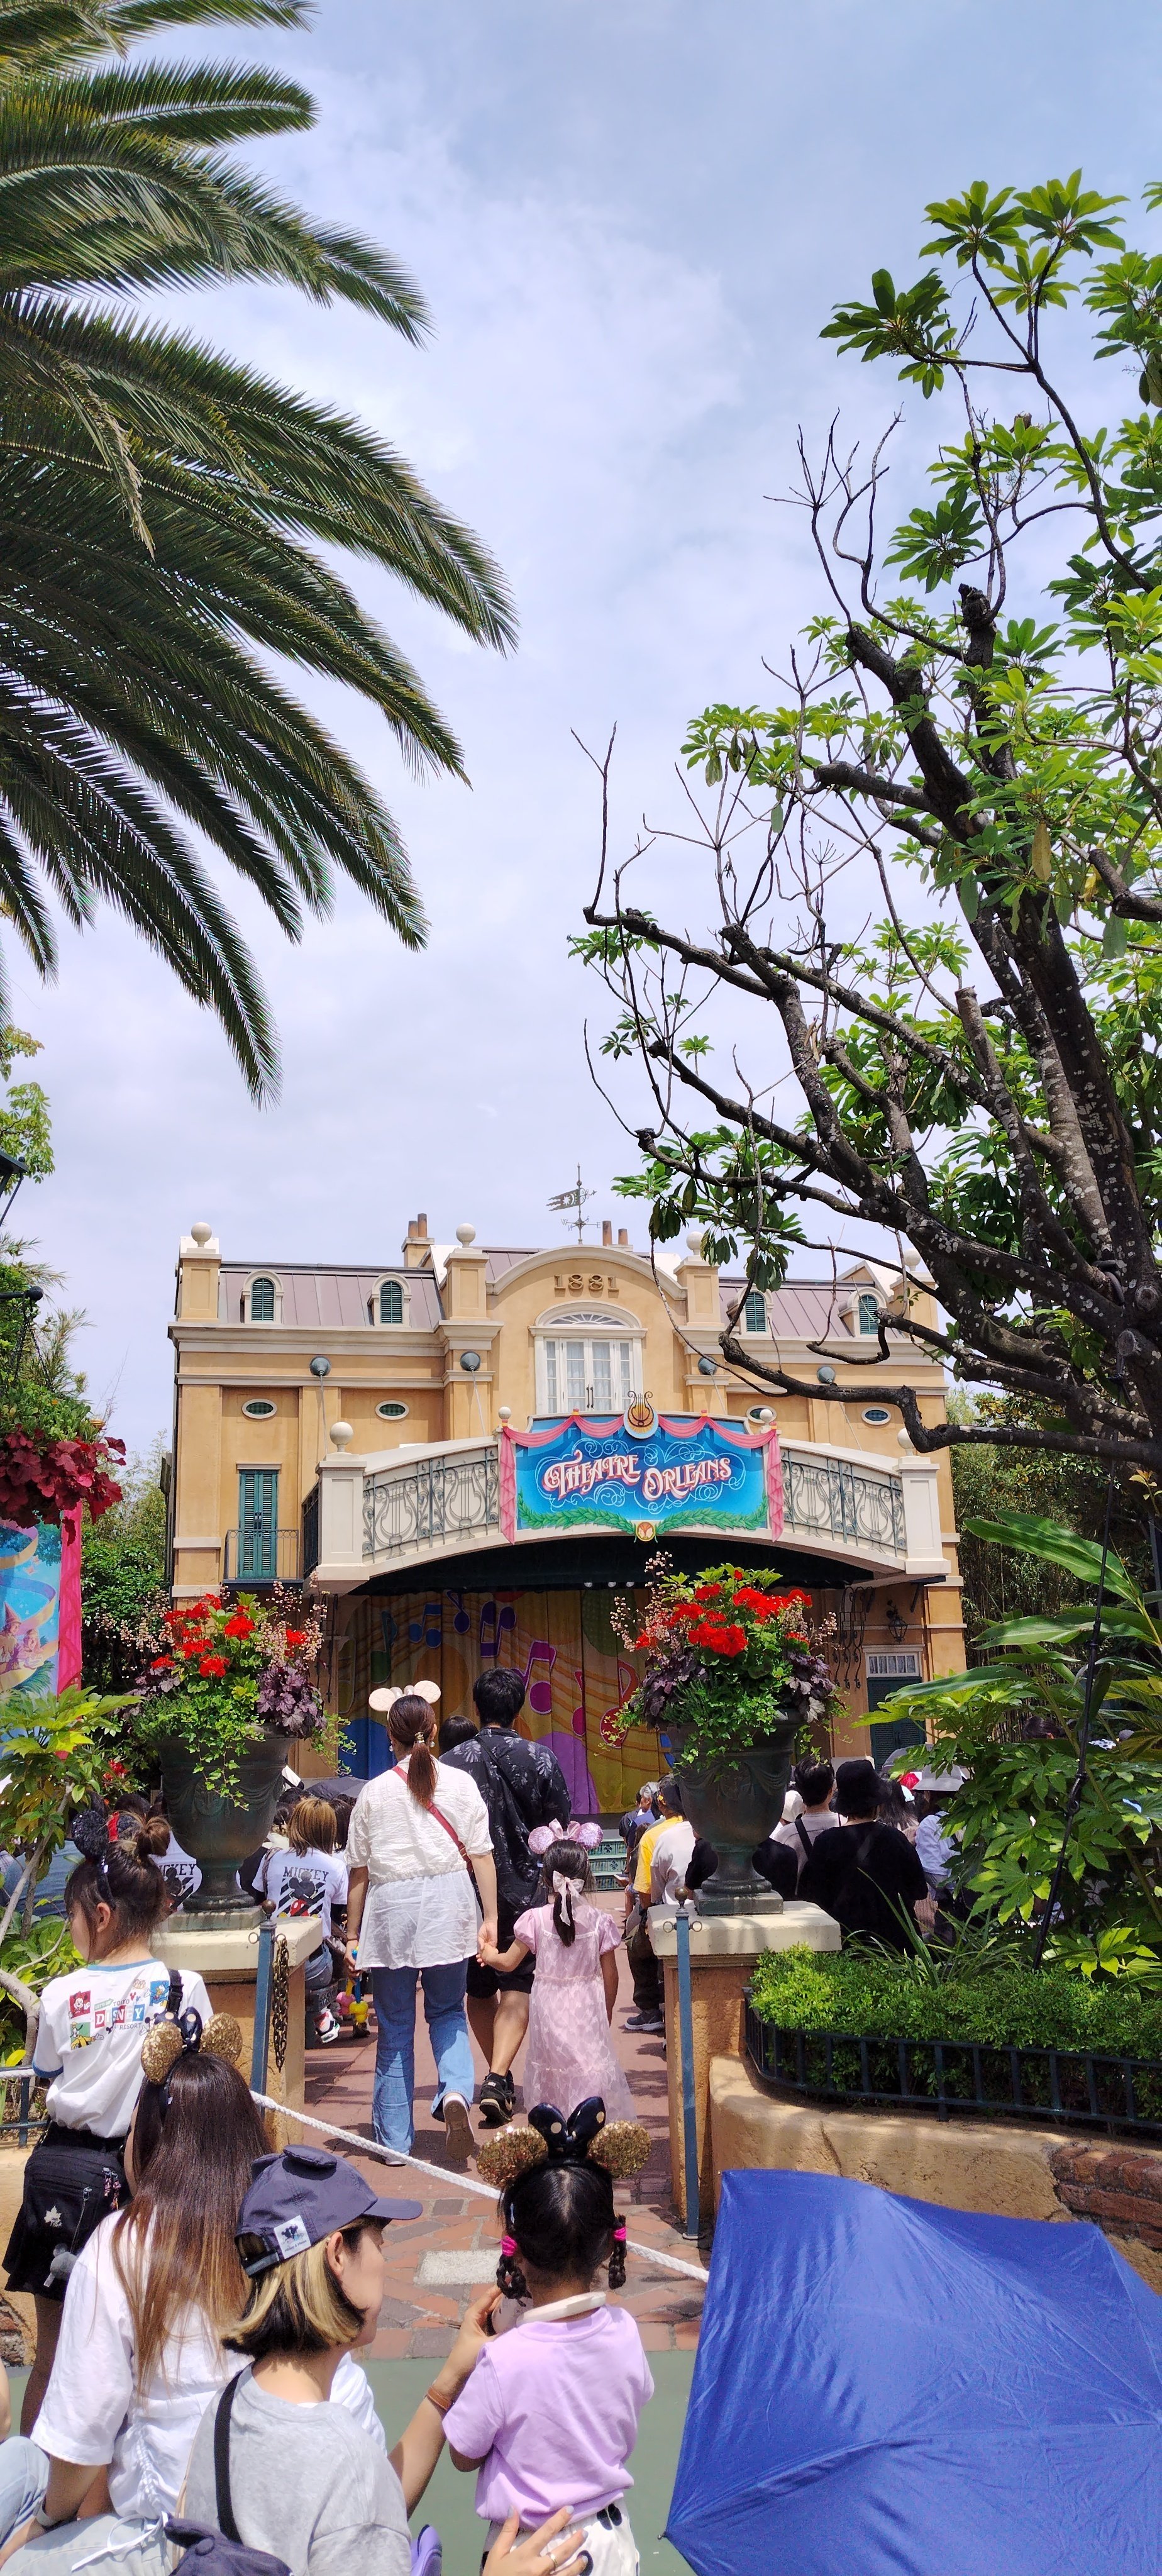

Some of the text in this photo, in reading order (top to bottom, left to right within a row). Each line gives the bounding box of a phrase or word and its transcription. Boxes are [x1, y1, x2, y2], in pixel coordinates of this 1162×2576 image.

[554, 1274, 619, 1291] 1881
[542, 1449, 732, 1501] THEATRE ORLEANS
[282, 1866, 329, 1882] MICEY
[96, 2006, 144, 2026] DISNEY
